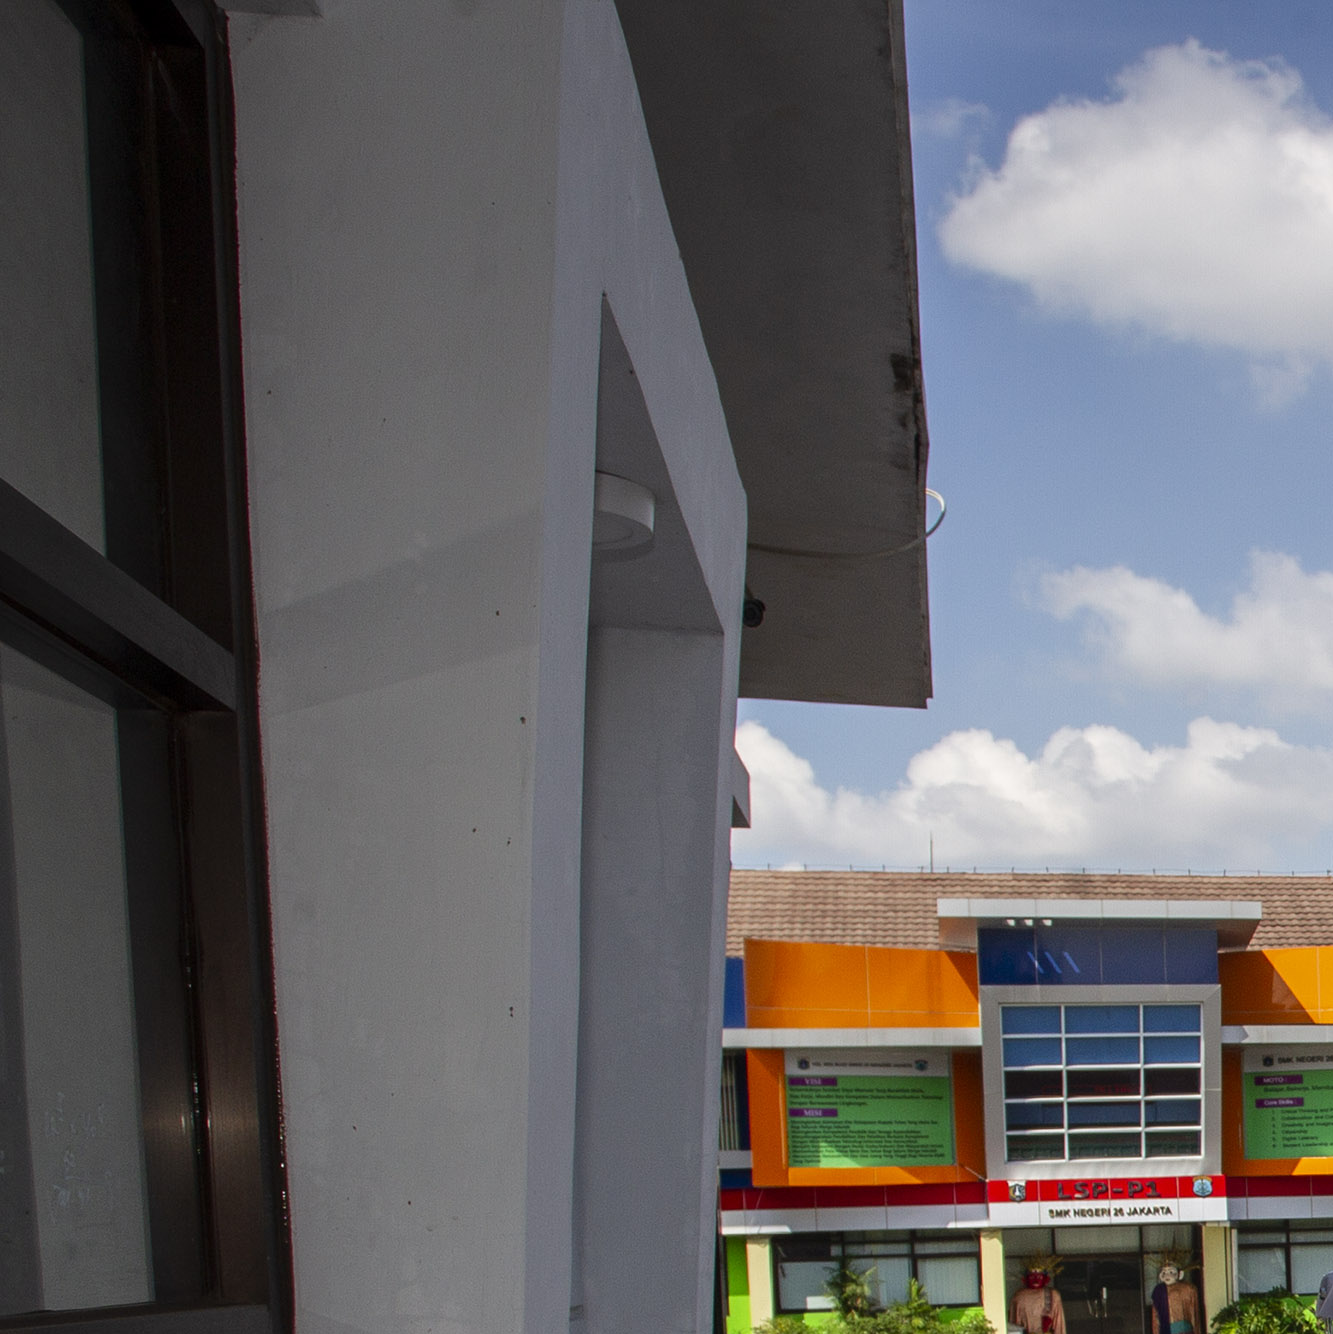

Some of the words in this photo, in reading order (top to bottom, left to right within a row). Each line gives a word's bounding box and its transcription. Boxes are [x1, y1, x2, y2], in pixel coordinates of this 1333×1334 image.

[1296, 1055, 1324, 1063] NEGERI
[1057, 1181, 1161, 1199] LSP-P1
[1049, 1208, 1071, 1218] SMK
[1073, 1207, 1111, 1217] NEGERI
[1113, 1207, 1125, 1217] 26
[1127, 1206, 1172, 1216] JAKARTA
